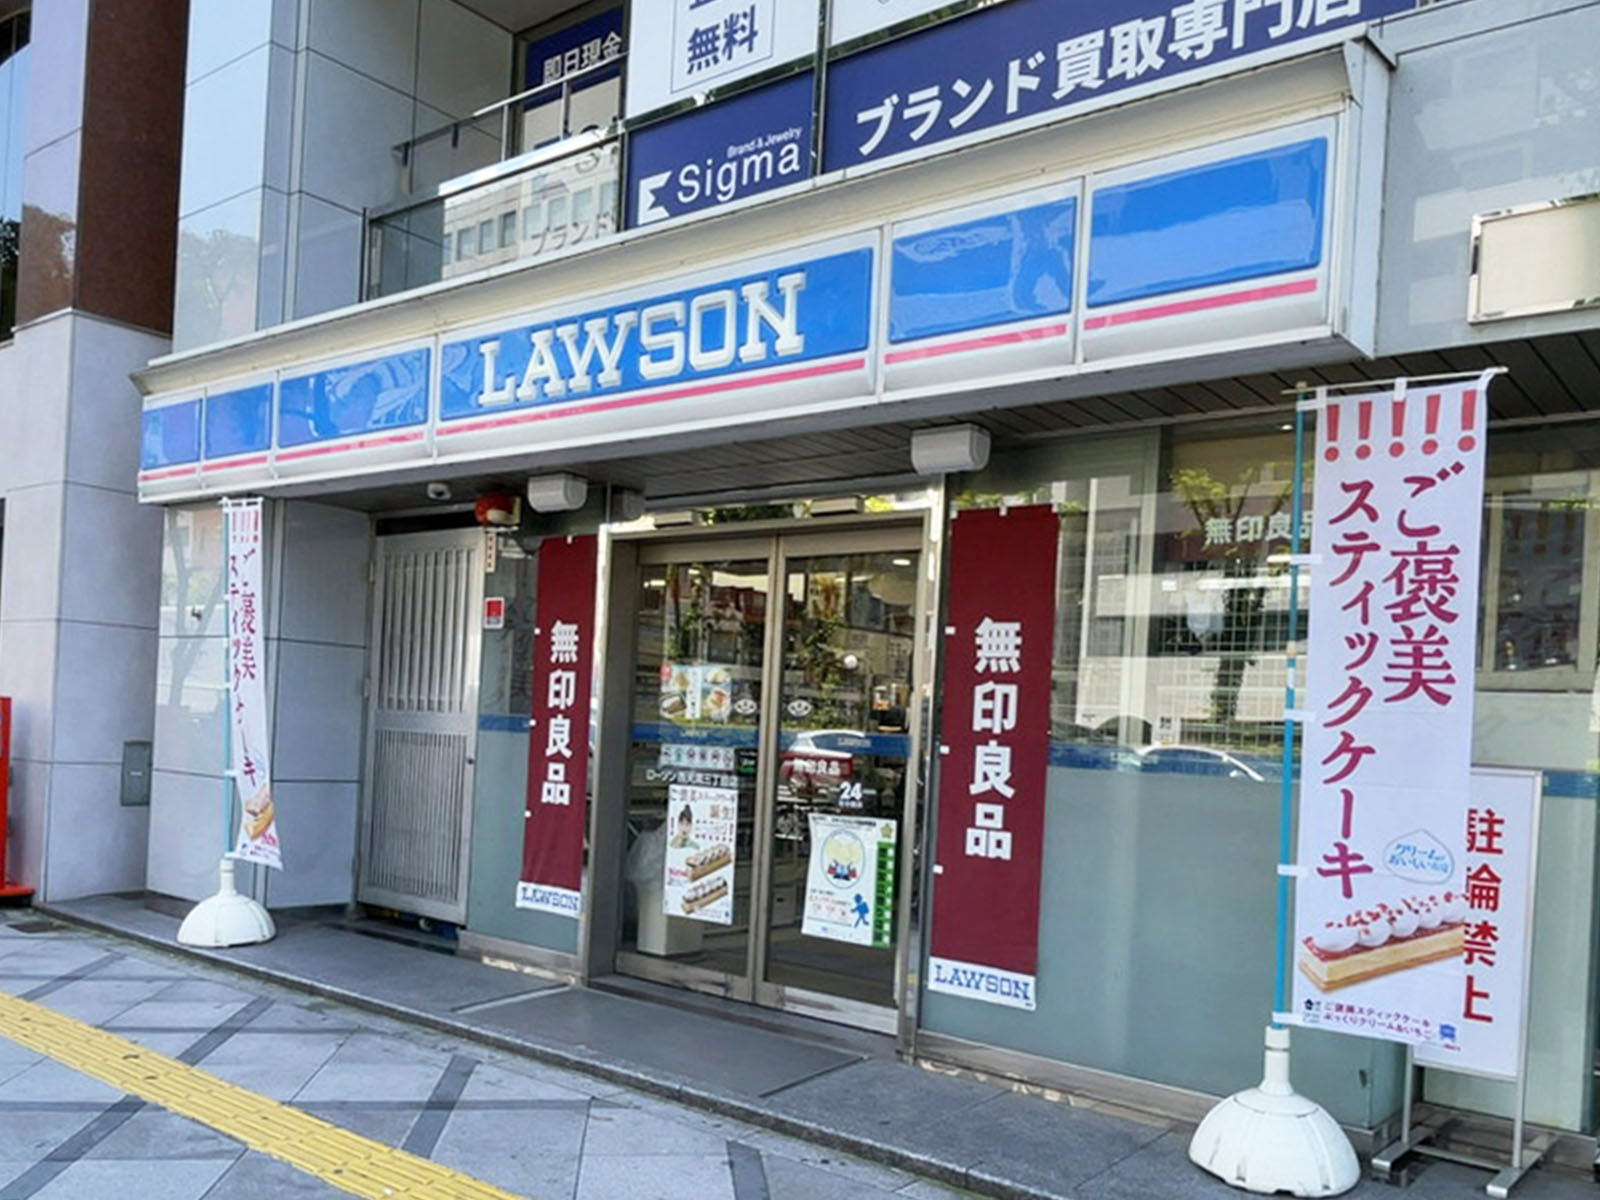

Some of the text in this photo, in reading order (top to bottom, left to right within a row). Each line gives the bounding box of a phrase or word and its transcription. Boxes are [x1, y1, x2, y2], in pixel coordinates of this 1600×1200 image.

[543, 31, 622, 85] 即日現金
[687, 4, 758, 75] 無料
[677, 143, 801, 202] Sigma
[477, 272, 807, 407] LAWSON
[1382, 461, 1465, 707] ご褒美
[540, 620, 580, 806] 無印良品
[1316, 479, 1382, 899] スティックケーキ
[965, 616, 1023, 861] 無印良品
[840, 781, 862, 801] 24
[521, 886, 579, 911] LAWSON
[935, 964, 1030, 1000] LAWSON
